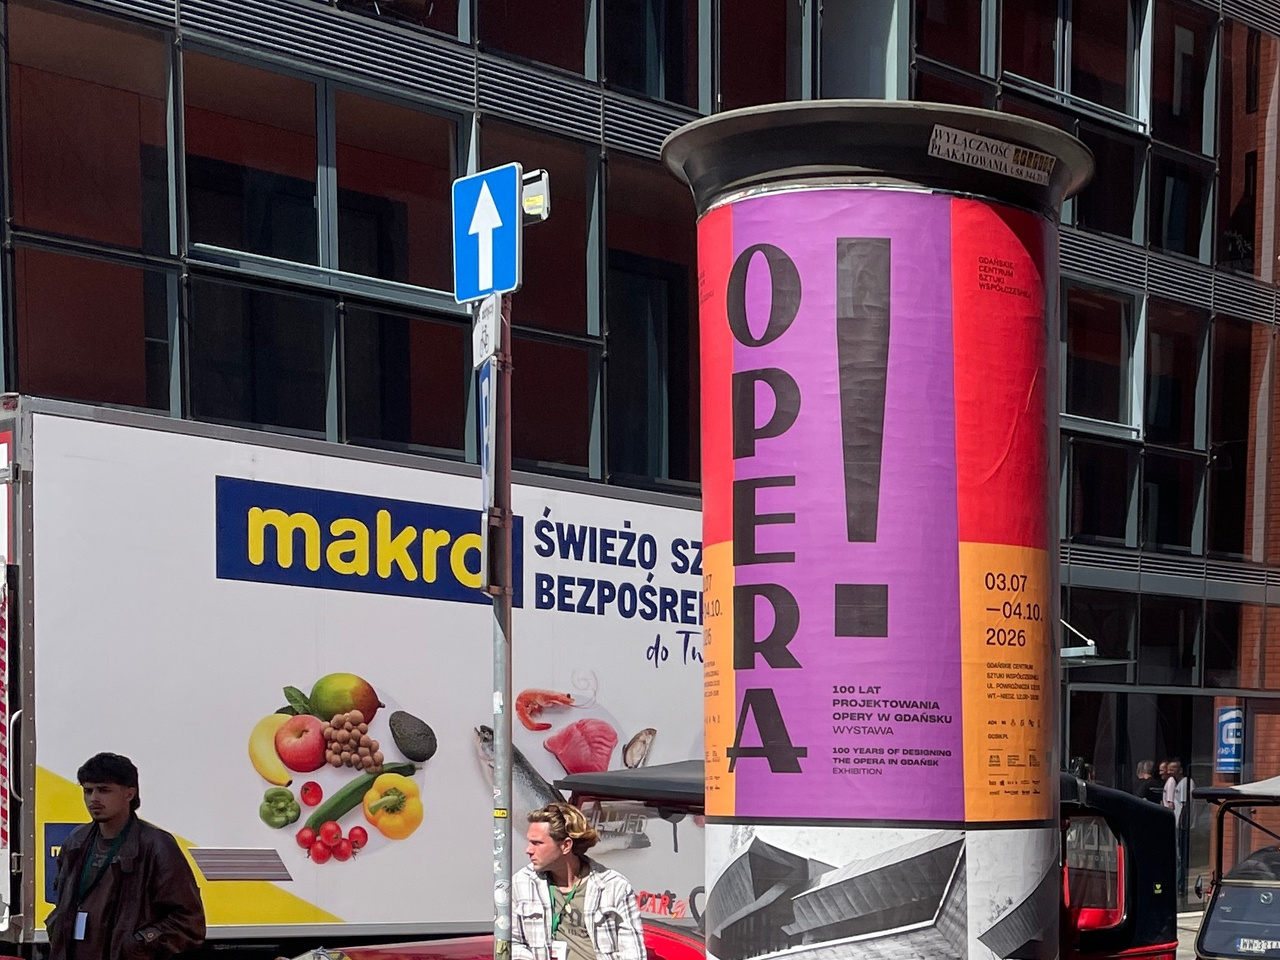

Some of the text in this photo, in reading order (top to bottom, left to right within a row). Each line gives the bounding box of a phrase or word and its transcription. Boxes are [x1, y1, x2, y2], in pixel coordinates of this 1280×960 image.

[931, 142, 1008, 173] PLAKATOWANIA
[979, 265, 1014, 277] CENTRUM
[533, 506, 658, 571] ŚWIEŻO
[248, 506, 483, 589] makro
[985, 572, 1028, 592] 03.07
[986, 628, 1026, 647] 2026
[646, 633, 669, 669] do
[833, 685, 881, 694] 100 LAT
[832, 699, 940, 710] PROJEKTOWANIA
[832, 712, 953, 724] OPERY W GDAŃSKU
[832, 725, 894, 735] WYSTAWA
[852, 747, 885, 755] YEARS
[902, 748, 952, 757] DESIGNING
[900, 757, 939, 766] GDAŃSK
[832, 767, 883, 775] EXHIBITION
